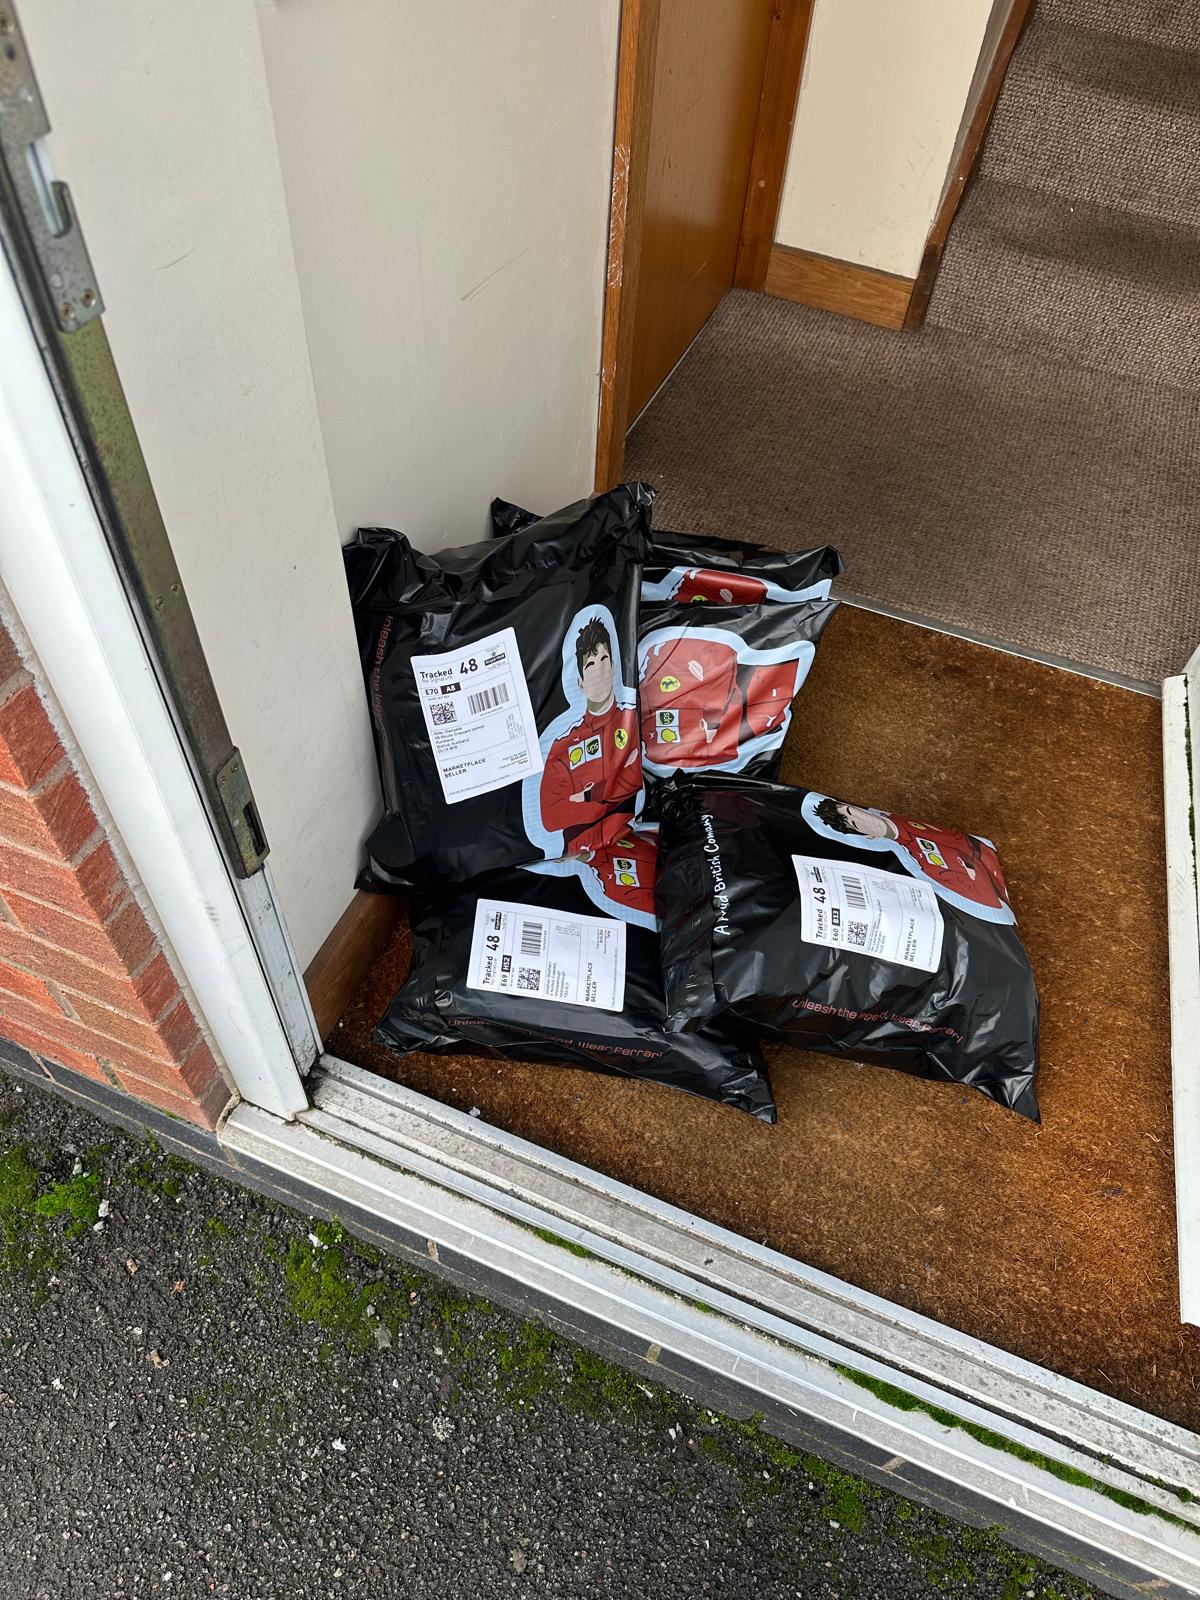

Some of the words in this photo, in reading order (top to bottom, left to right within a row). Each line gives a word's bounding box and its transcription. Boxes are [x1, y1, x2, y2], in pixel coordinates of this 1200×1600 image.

[420, 668, 453, 679] Tracked
[459, 658, 479, 674] 48
[425, 688, 439, 696] E70
[443, 758, 486, 774] MARKETPLACE
[444, 768, 467, 779] SELLER
[706, 855, 727, 893] British
[813, 886, 826, 904] 48
[713, 924, 731, 936] A
[904, 918, 915, 960] MARKETPLACE
[486, 934, 500, 951] 48
[483, 956, 494, 985] Tracked
[585, 962, 593, 1002] MARKETPLACE
[791, 998, 836, 1016] Unleash
[837, 1007, 858, 1020] the
[613, 1046, 663, 1060] Ferrari
